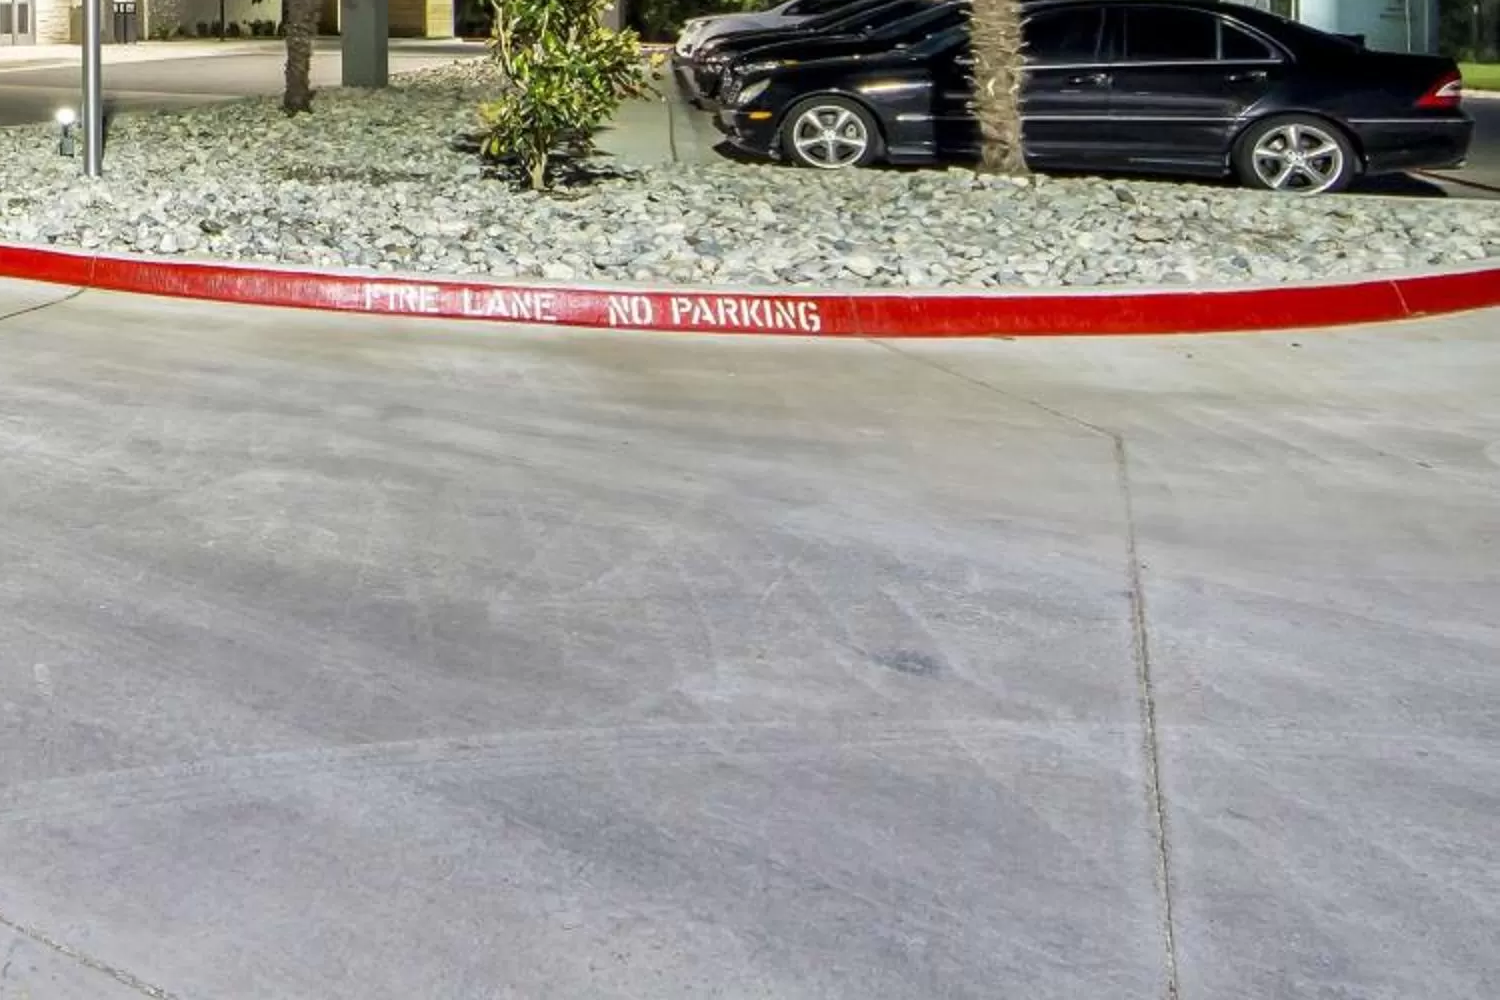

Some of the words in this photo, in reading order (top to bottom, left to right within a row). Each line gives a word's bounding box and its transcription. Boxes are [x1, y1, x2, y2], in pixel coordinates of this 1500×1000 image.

[463, 287, 557, 321] LANE
[608, 296, 653, 326] NO
[671, 297, 821, 332] PARKING
